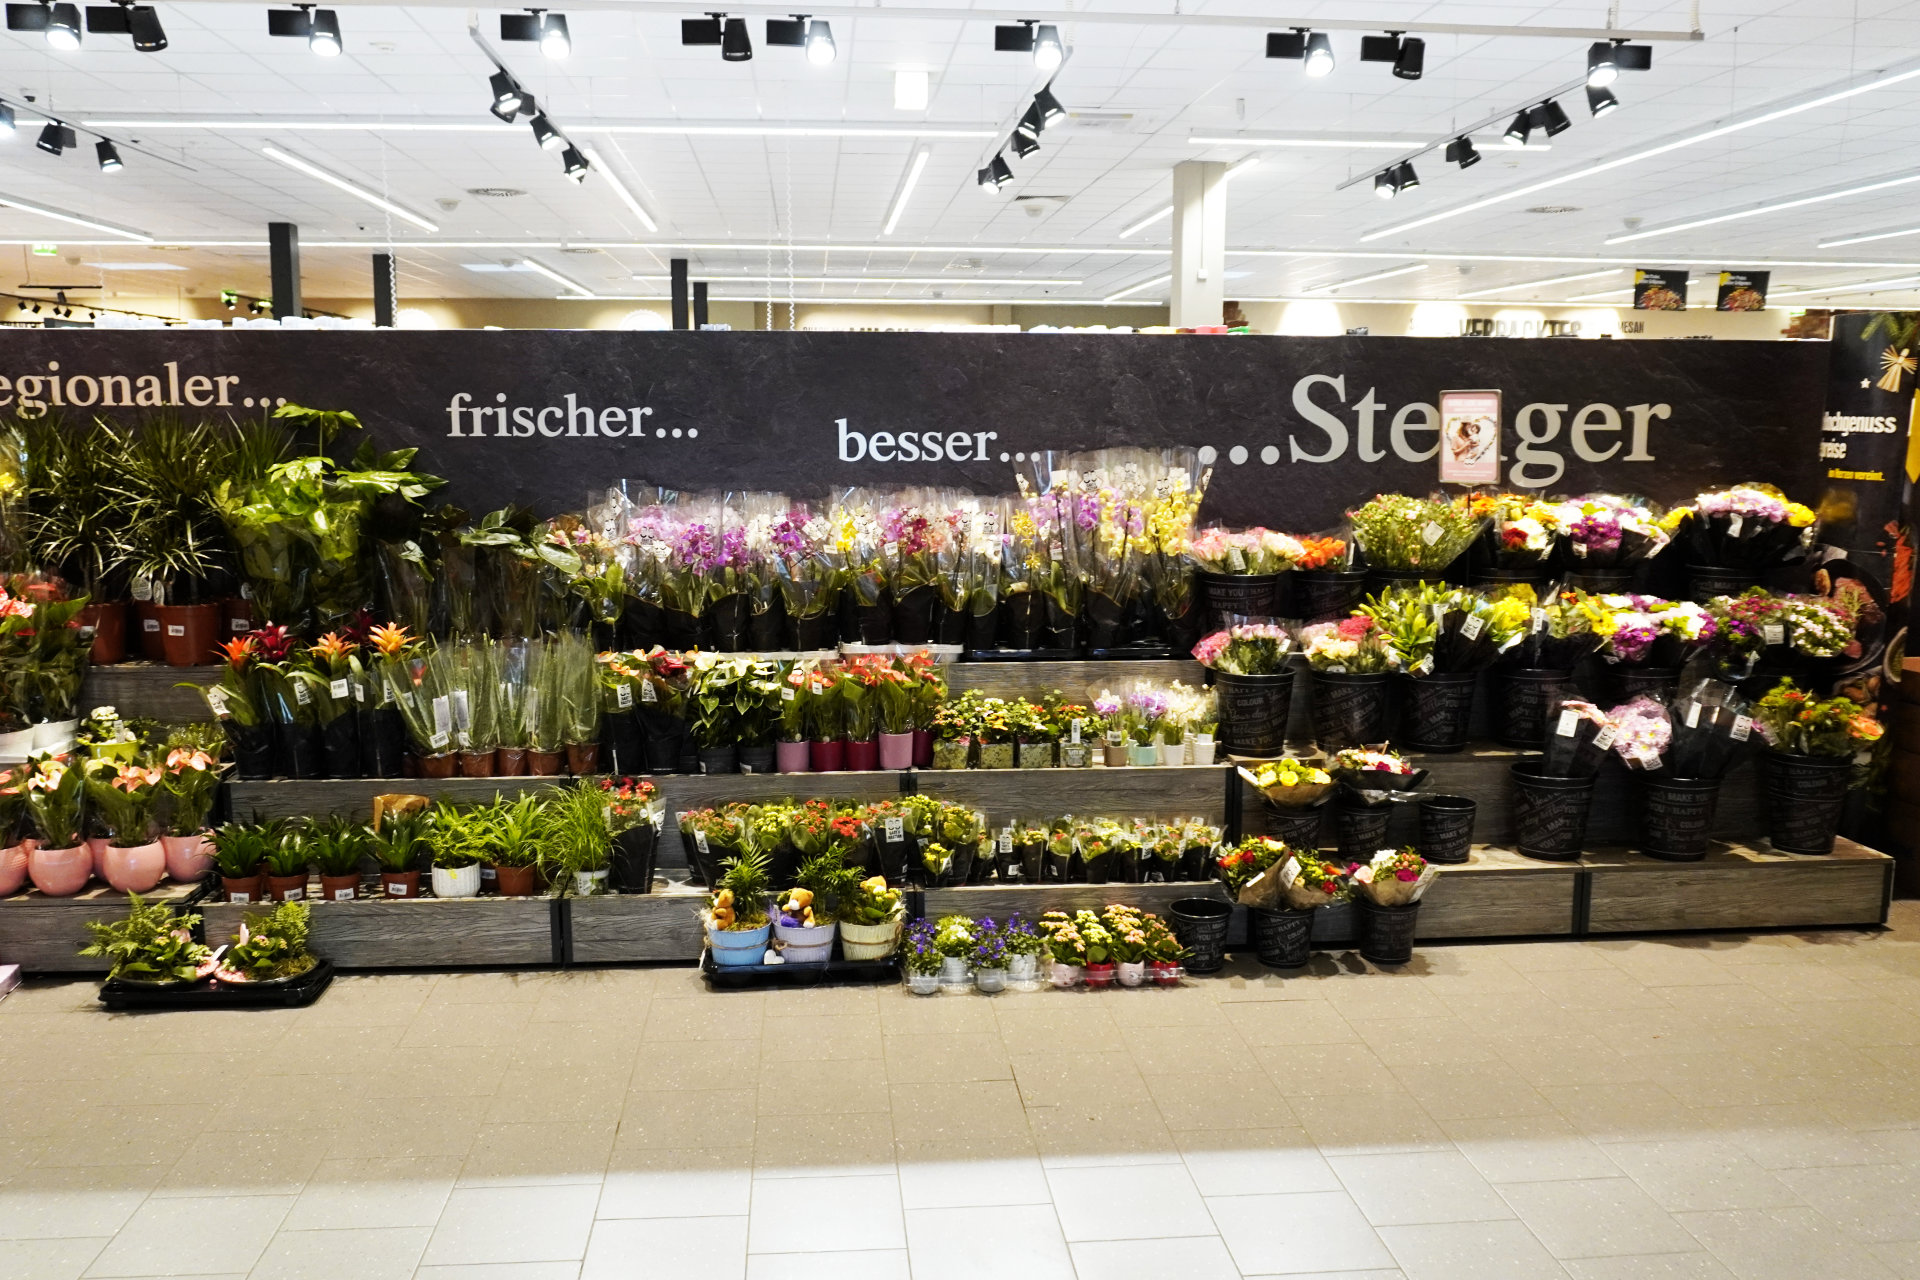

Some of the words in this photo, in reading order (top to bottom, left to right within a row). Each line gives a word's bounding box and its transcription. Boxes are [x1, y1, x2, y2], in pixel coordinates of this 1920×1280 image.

[446, 392, 699, 438] frischer...
[1198, 374, 1671, 488] ...Steger
[835, 418, 1041, 462] besser...
